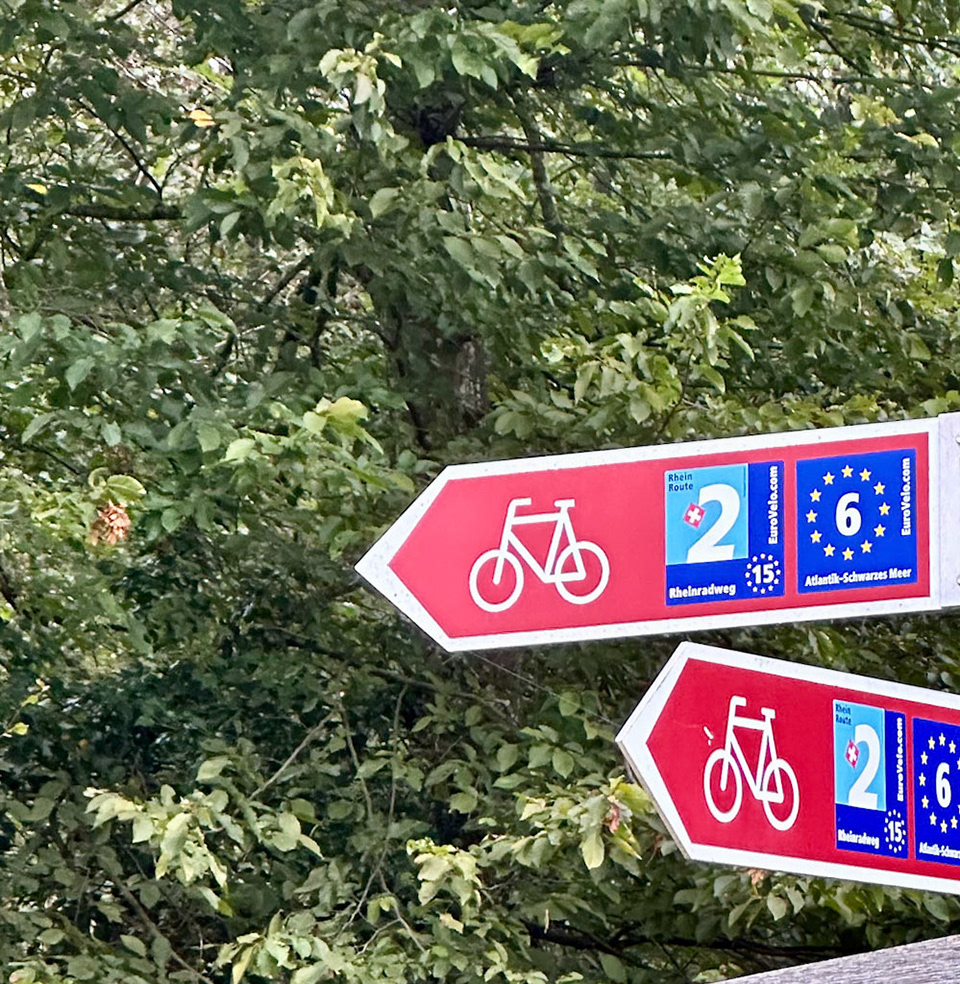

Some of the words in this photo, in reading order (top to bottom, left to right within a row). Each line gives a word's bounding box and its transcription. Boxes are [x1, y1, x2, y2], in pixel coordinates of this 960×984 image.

[668, 473, 692, 483] Rhein
[668, 482, 694, 492] Route
[901, 457, 911, 536] EuroVelo.com
[686, 483, 741, 564] 2
[768, 465, 778, 545] EuroVelo.com
[835, 492, 862, 536] 6
[669, 583, 736, 600] Rheinradweg
[752, 564, 775, 584] 15
[804, 569, 888, 587] Atlantik-Schwarzes
[889, 567, 912, 581] Meer
[848, 723, 881, 811] 2
[896, 717, 904, 802] EuroVelo.com
[935, 762, 952, 808] 6
[888, 821, 902, 843] 15
